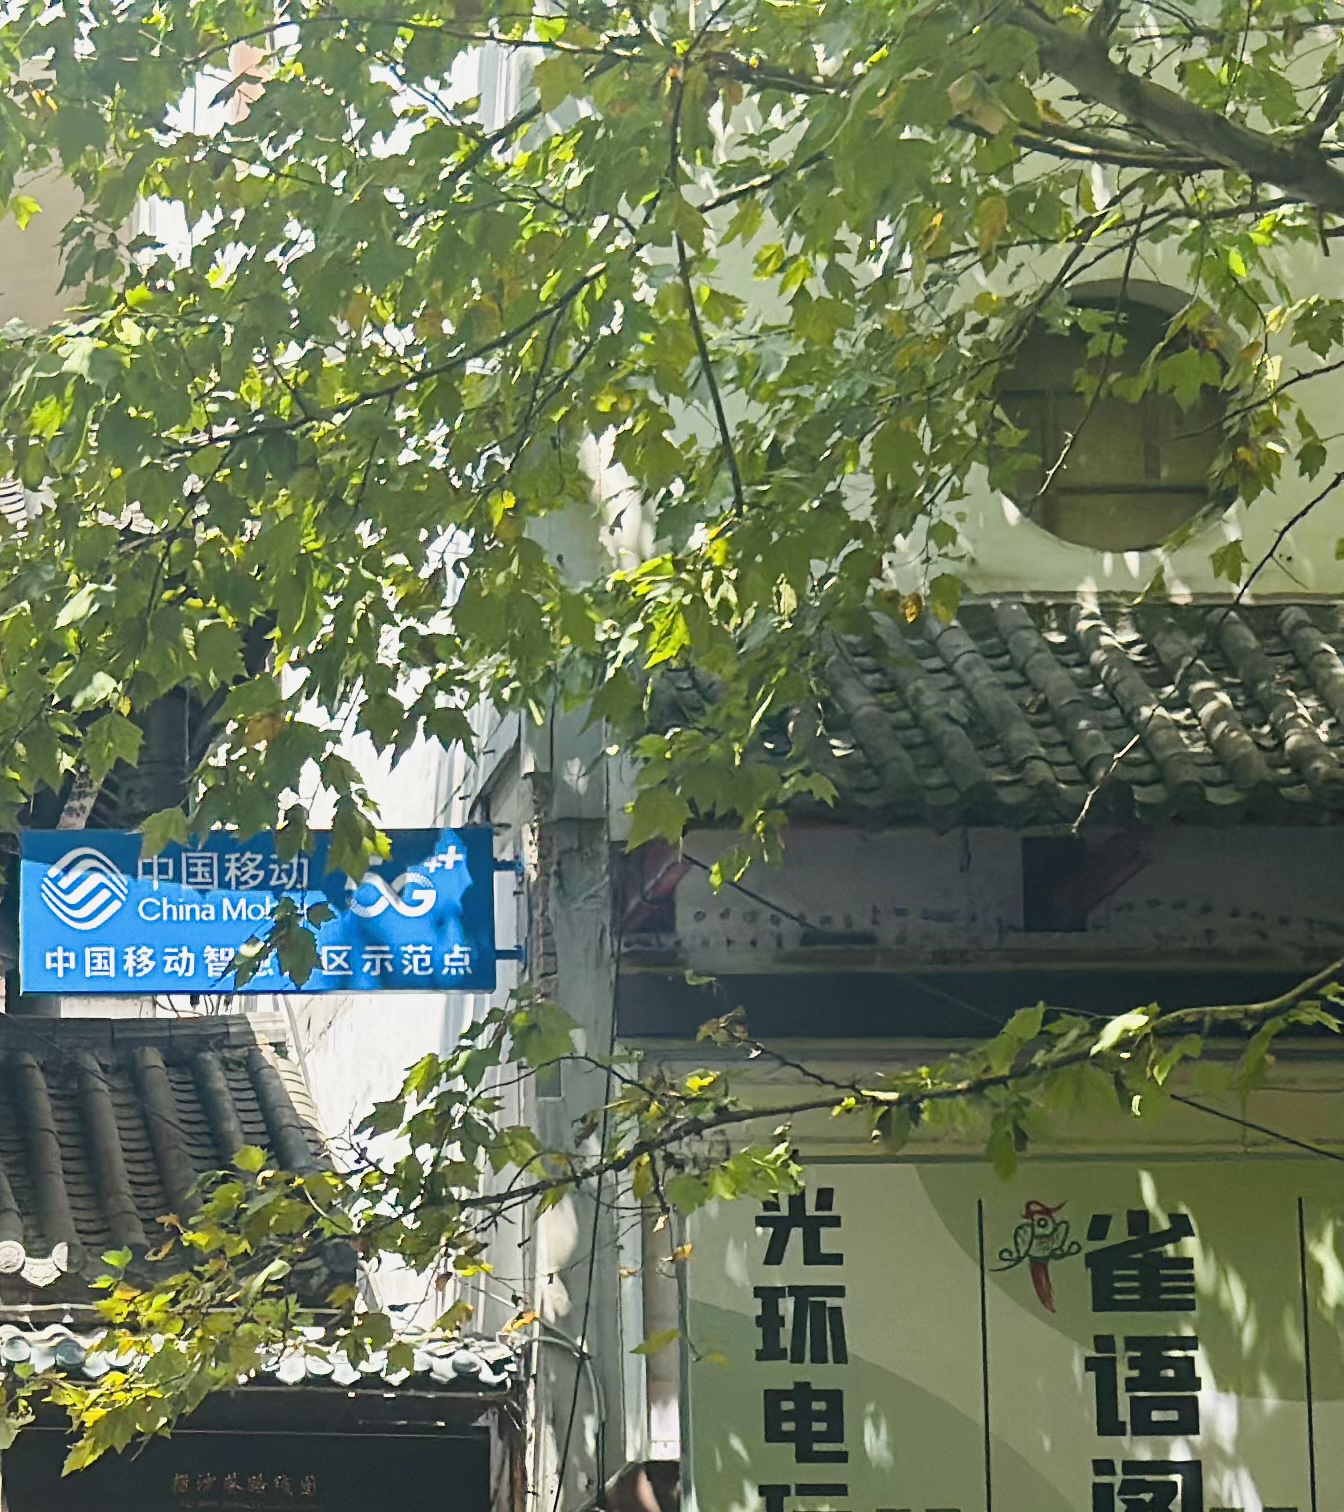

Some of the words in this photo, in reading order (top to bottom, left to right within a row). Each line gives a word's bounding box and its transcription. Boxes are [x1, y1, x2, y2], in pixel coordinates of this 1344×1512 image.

[137, 851, 310, 891] 中国移动
[138, 896, 215, 923] China
[44, 945, 473, 977] 中国移动智区示范点
